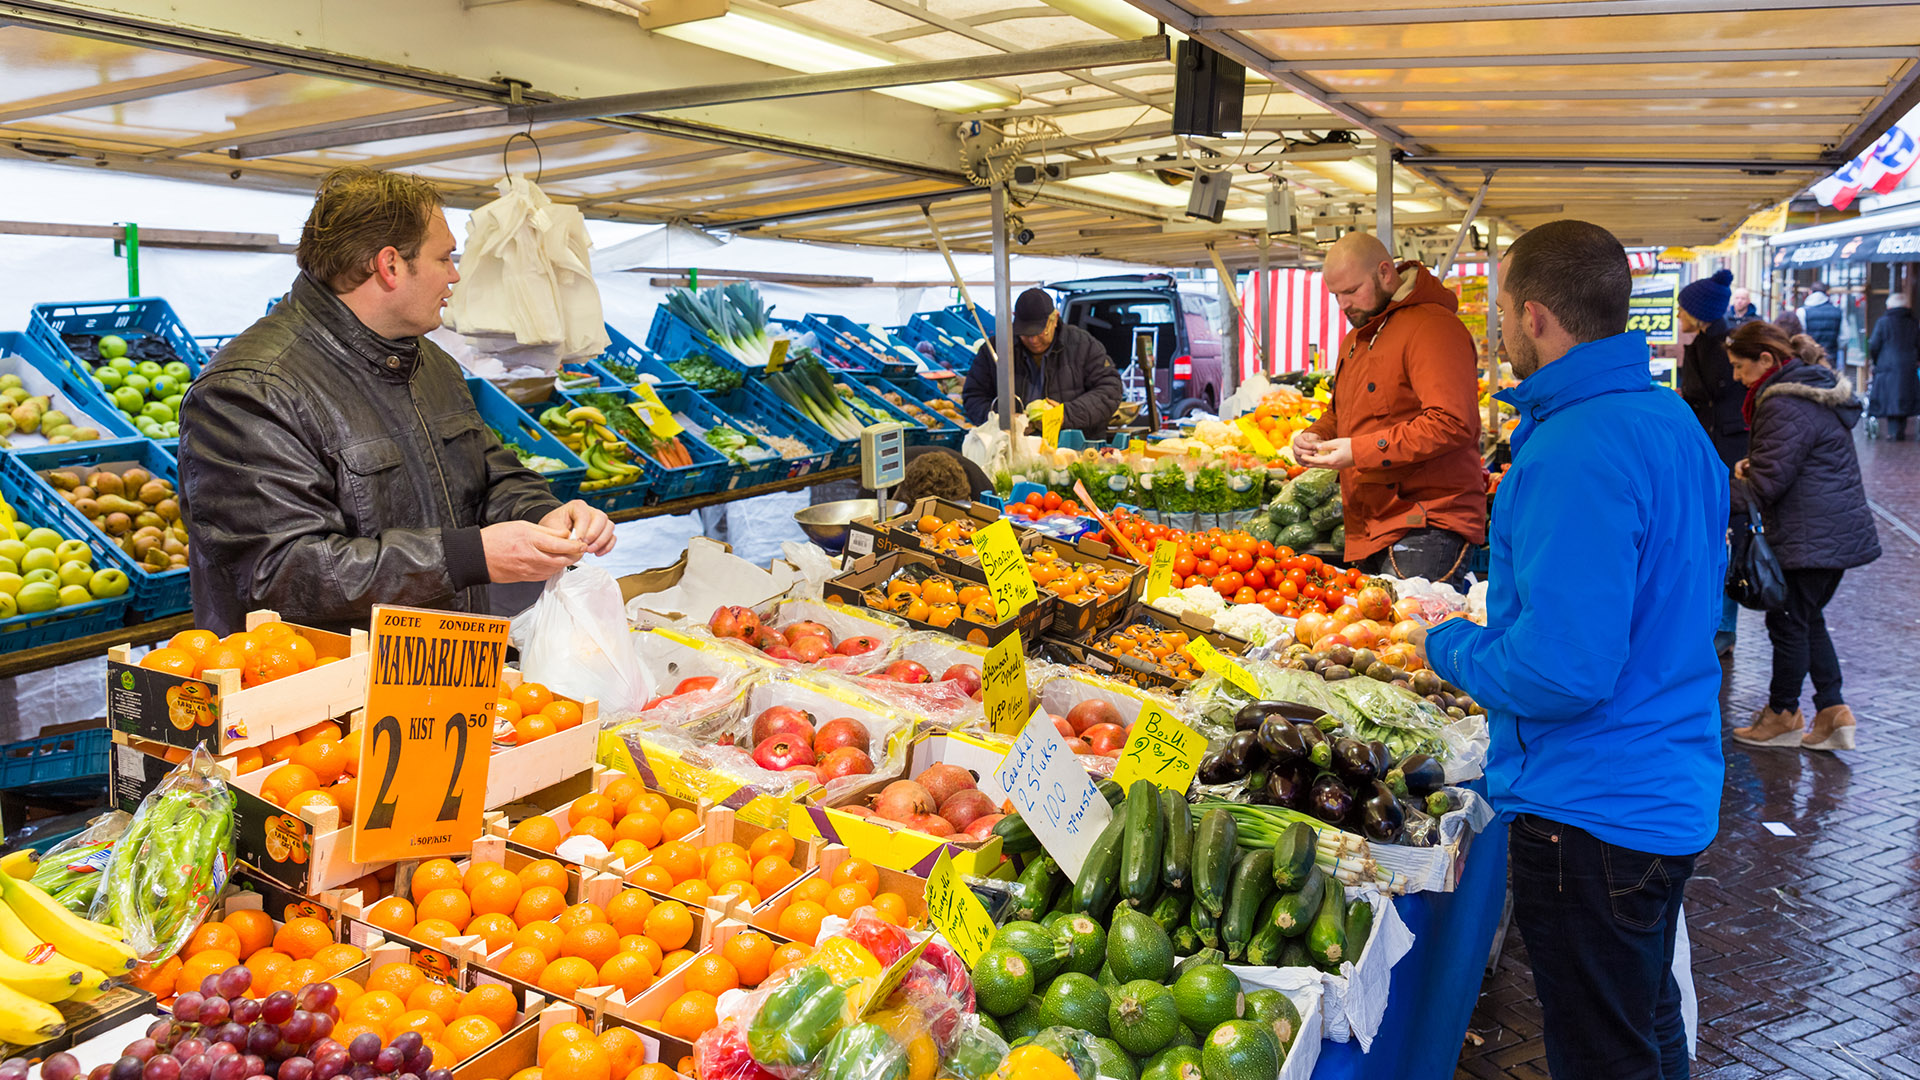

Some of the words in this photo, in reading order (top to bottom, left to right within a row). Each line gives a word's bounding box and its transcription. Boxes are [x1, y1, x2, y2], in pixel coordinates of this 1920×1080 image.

[384, 615, 422, 628] ZOETE
[438, 619, 486, 633] ZONDER
[488, 623, 506, 634] PIT
[374, 633, 502, 688] MANDARIJNEN
[484, 702, 495, 711] CT
[1127, 736, 1151, 764] 2
[363, 715, 403, 831] 2
[408, 717, 436, 740] KIST
[1018, 788, 1035, 812] 2
